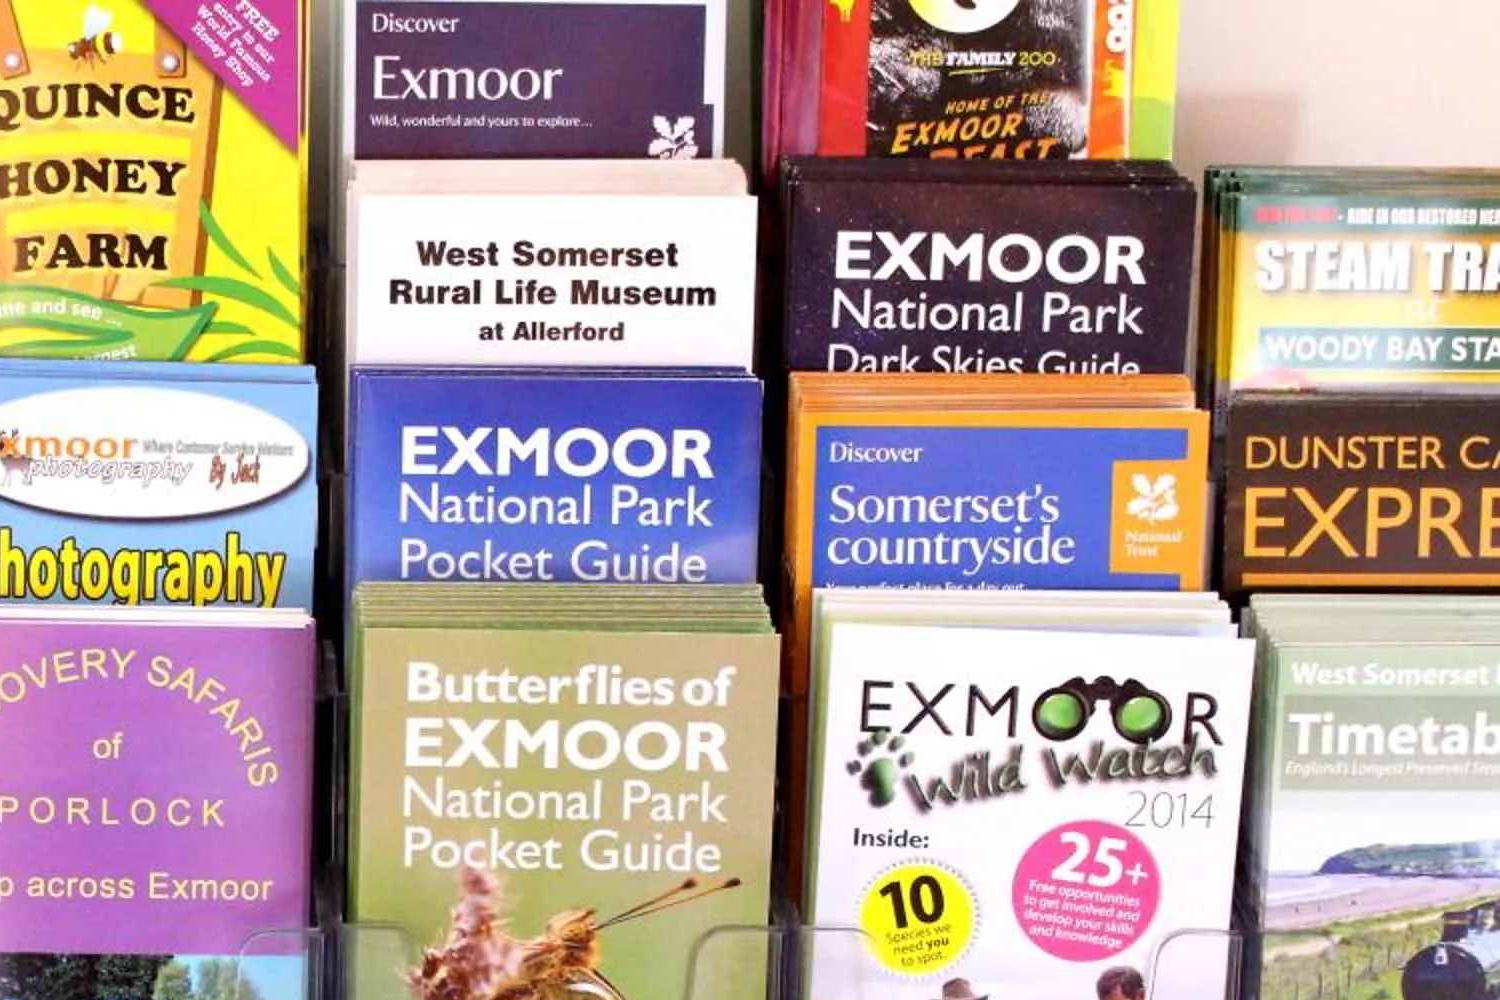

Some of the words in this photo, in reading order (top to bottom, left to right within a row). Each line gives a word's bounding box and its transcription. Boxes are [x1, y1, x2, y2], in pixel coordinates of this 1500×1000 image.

[371, 14, 459, 33] Discover
[373, 55, 563, 100] Exmoor
[890, 113, 1024, 154] EXMOOR
[14, 233, 168, 273] FARM
[416, 241, 498, 267] West
[513, 241, 678, 268] Somerset
[835, 231, 1147, 285] EXMOOR
[389, 280, 481, 305] Rural
[494, 280, 557, 305] Life
[571, 281, 716, 306] Museum
[30, 299, 67, 316] and
[71, 303, 102, 320] see
[831, 289, 1022, 333] National
[1043, 292, 1143, 336] Park
[479, 323, 504, 341] at
[513, 322, 625, 341] Allerford
[1264, 335, 1377, 361] WOODY
[1387, 336, 1443, 362] BAY
[401, 427, 714, 478] EXMOOR
[829, 442, 923, 463] Discover
[400, 484, 591, 525] National
[612, 485, 713, 527] Park
[829, 485, 1060, 524] Somerset's
[827, 525, 1075, 575] countryside
[1125, 531, 1182, 544] National
[1125, 545, 1158, 557] Trust
[401, 539, 552, 580] Pocket
[570, 541, 707, 582] Guide
[406, 661, 673, 705] Butterflies
[682, 666, 737, 706] of
[1291, 663, 1357, 685] West
[1363, 663, 1489, 686] Somerset
[147, 656, 278, 788] SAFARIS
[93, 732, 124, 758] of
[404, 717, 729, 772] EXMOOR
[904, 745, 1027, 813] Wild
[1039, 733, 1218, 788] Watch
[402, 776, 600, 820] National
[623, 780, 727, 822] Park
[1124, 791, 1215, 829] 2014
[403, 826, 561, 870] Pocket
[580, 830, 722, 872] Guide
[853, 827, 930, 849] Inside:
[27, 876, 135, 898] across
[148, 872, 273, 900] Exmoor
[1029, 880, 1055, 895] Free
[1058, 883, 1141, 908] opportunities
[879, 874, 945, 929] 10
[1023, 895, 1036, 905] to
[1039, 896, 1060, 910] get
[1064, 899, 1114, 918] involved
[1116, 909, 1140, 922] and
[886, 926, 931, 943] Species
[934, 924, 952, 935] we
[1023, 909, 1073, 927] develop
[1075, 917, 1102, 932] your
[1104, 920, 1135, 936] skills
[1029, 924, 1051, 937] and
[1054, 926, 1122, 949] knowledge
[893, 940, 924, 955] need
[925, 936, 949, 952] you
